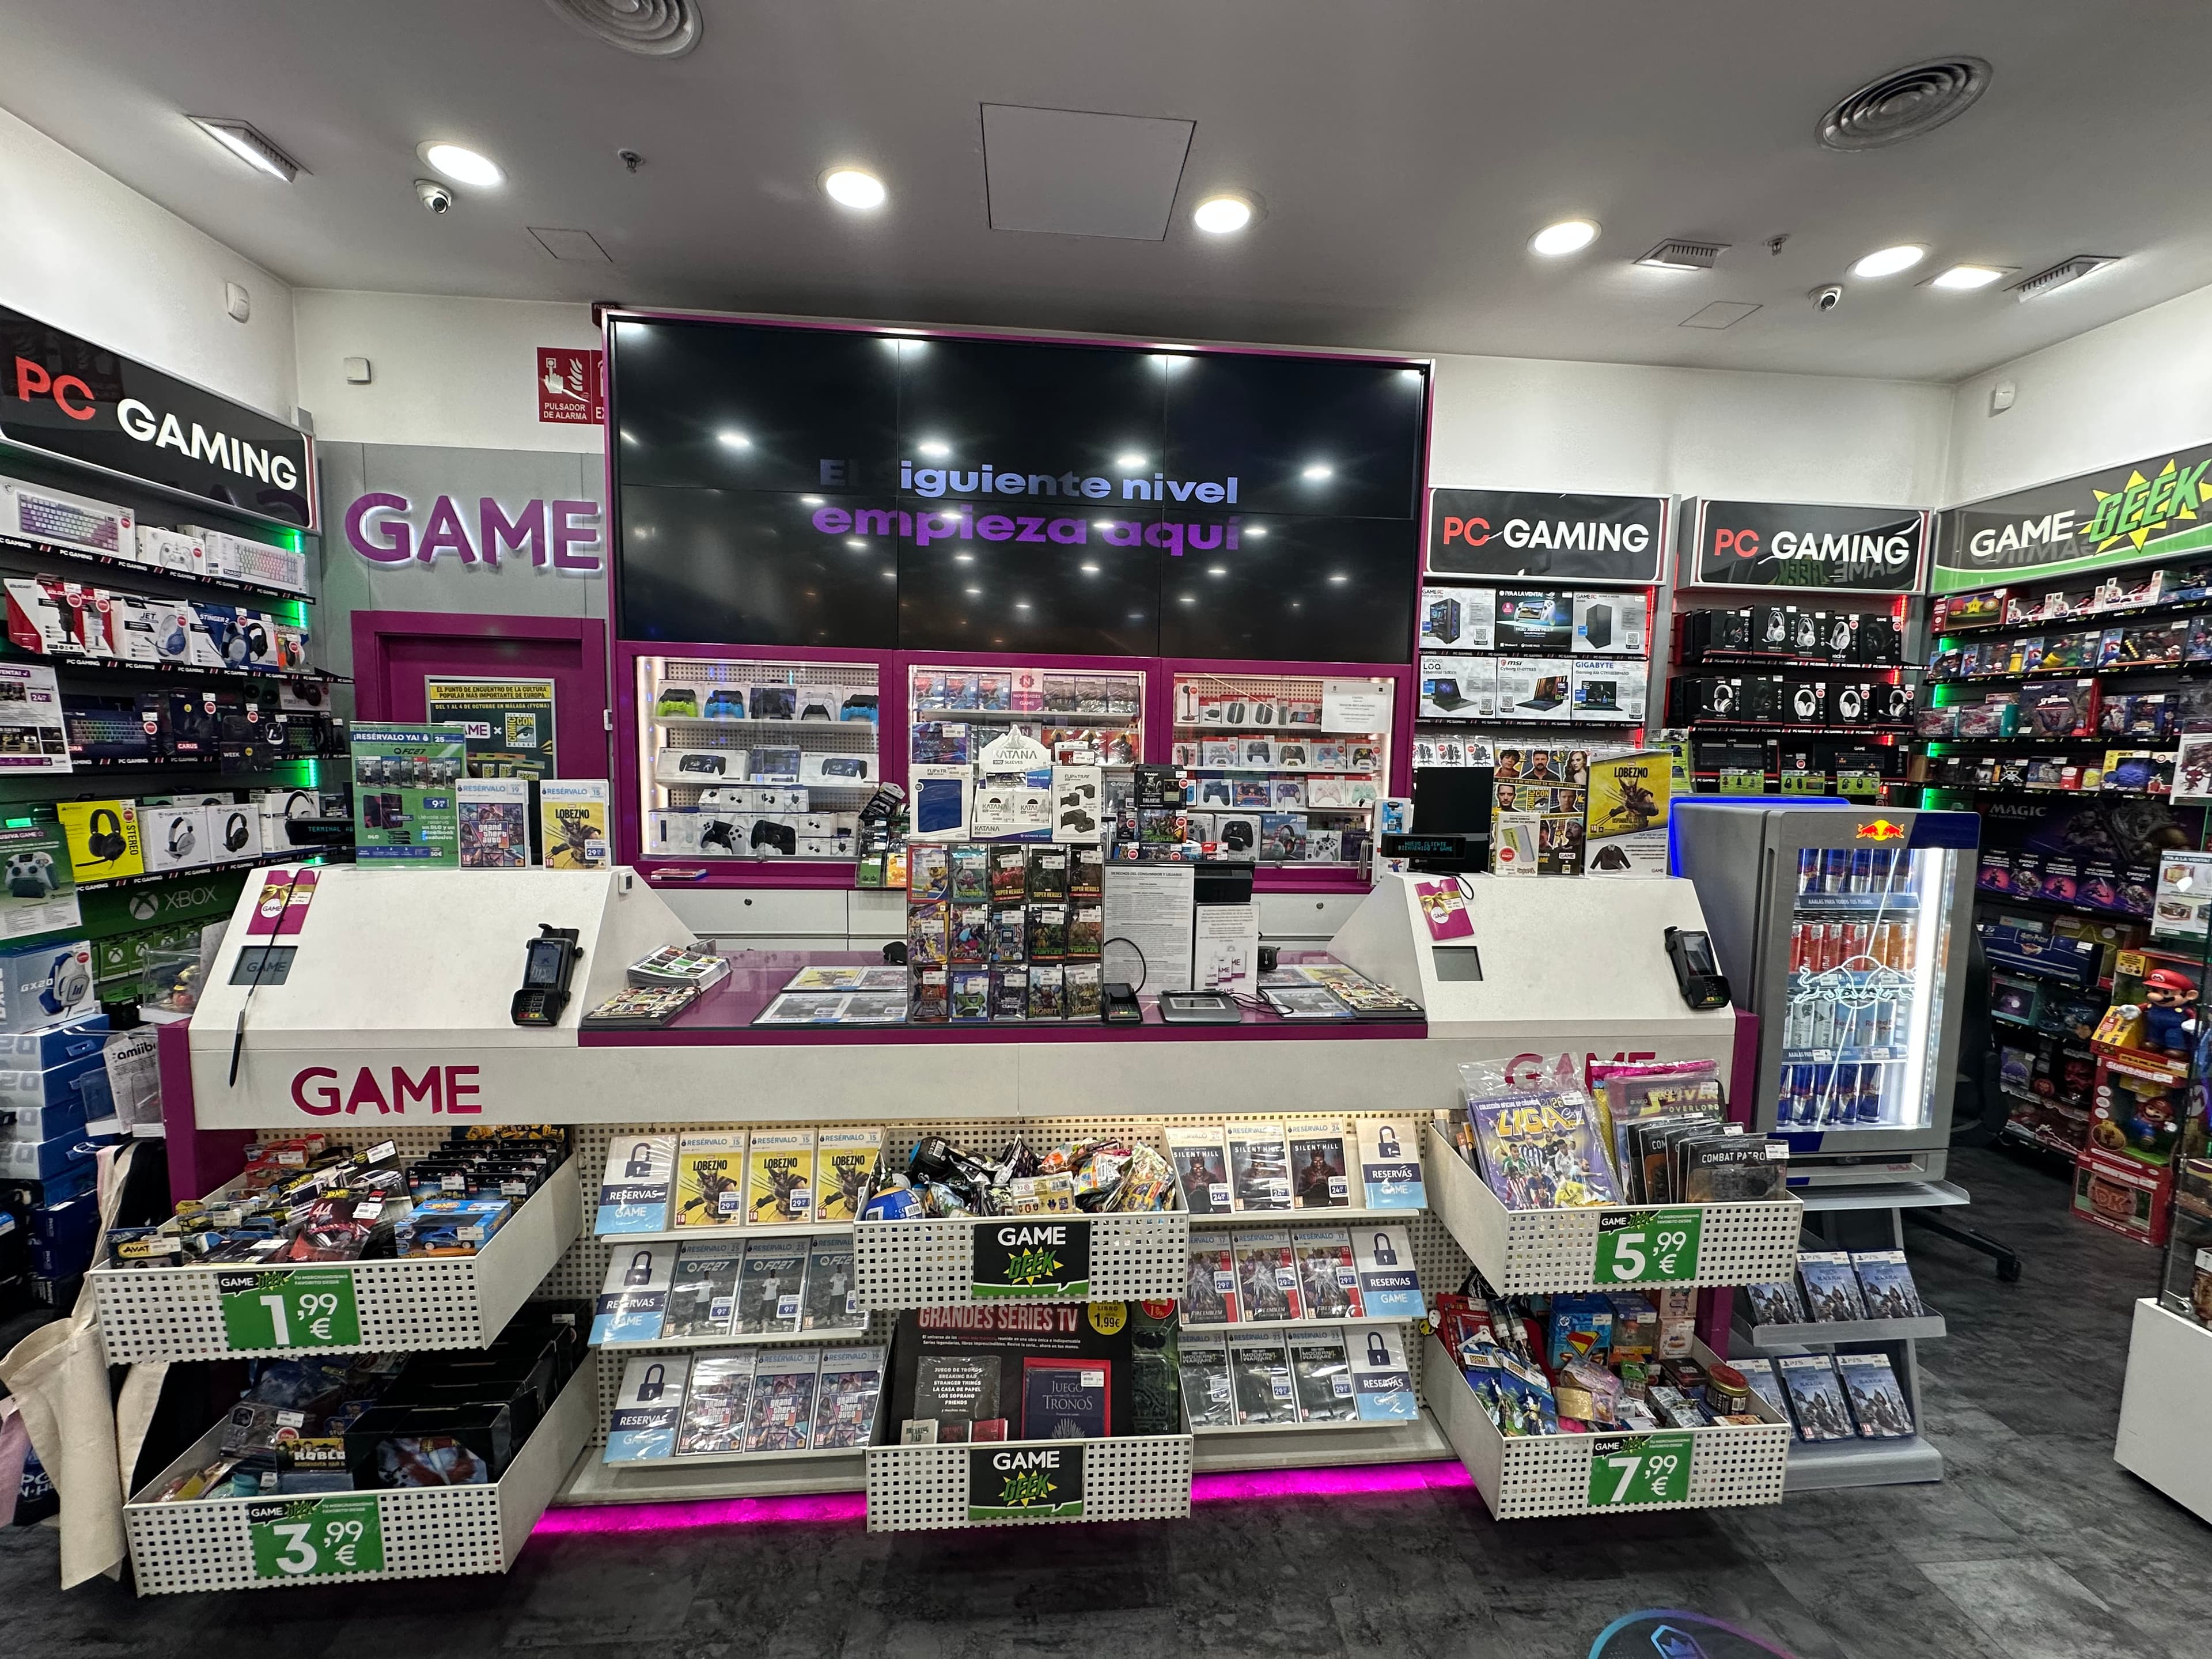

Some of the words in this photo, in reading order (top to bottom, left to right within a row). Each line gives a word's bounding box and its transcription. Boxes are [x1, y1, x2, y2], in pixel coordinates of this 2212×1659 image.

[545, 403, 585, 411] PULSADOR
[15, 357, 96, 420] PC
[117, 398, 297, 490] GAMING
[901, 460, 1111, 498] iguiente
[1123, 473, 1237, 503] nivel
[1970, 510, 2075, 557] GAME
[2089, 459, 2212, 543] GEEK
[346, 493, 599, 569] GAME
[812, 504, 1086, 546] empieza
[1103, 516, 1239, 556] aquí
[1444, 517, 1490, 546] PC
[1504, 518, 1649, 552] GAMING
[1714, 529, 1759, 557] PC
[1771, 531, 1908, 564] GAMING
[70, 551, 93, 560] GAMING
[200, 613, 223, 623] STINGER
[508, 717, 517, 741] COMIC
[354, 733, 404, 741] ¡RESÉRVALO
[1614, 767, 1648, 778] LOBEZNO
[463, 785, 505, 793] RESÉRVALO
[555, 809, 589, 819] LOBEZNO
[1990, 804, 2047, 817] MAGIC
[479, 823, 502, 832] grand
[126, 825, 138, 855] STEREO
[165, 885, 217, 910] XBOX
[291, 1066, 482, 1115] GAME
[1541, 1097, 1563, 1108] 2026
[1669, 1104, 1719, 1112] OVERLORD
[1498, 1105, 1575, 1137] LIGA
[1293, 1124, 1328, 1132] RESÉRVALO
[757, 1137, 797, 1145] RESÉRVALO
[832, 1156, 865, 1166] LOBEZNO
[1702, 1153, 1733, 1162] COMBAT
[693, 1160, 728, 1171] LOBEZNO
[1372, 1169, 1412, 1179] RESERVAS
[609, 1189, 658, 1201] RESERVAS
[1601, 1217, 1627, 1226] GAME
[997, 1226, 1066, 1246] GAME
[1298, 1233, 1334, 1241] RESÉRVALO
[698, 1262, 729, 1272] FC27
[1007, 1250, 1054, 1280] GEEK
[221, 1278, 253, 1287] GAME
[1370, 1278, 1411, 1286] RESERVAS
[1380, 1294, 1408, 1303] GAME
[919, 1306, 994, 1328] GRANDES
[998, 1306, 1054, 1331] SERIES
[1058, 1308, 1078, 1332] TV
[1094, 1313, 1120, 1328] 1,99€
[1052, 1381, 1084, 1394] JUEGO
[1042, 1395, 1093, 1410] TRONOS
[1804, 1427, 1812, 1435] 18
[1595, 1442, 1619, 1450] GAME
[993, 1450, 1059, 1470] GAME
[1004, 1472, 1050, 1502] GEEK
[251, 1507, 283, 1517] GAME
